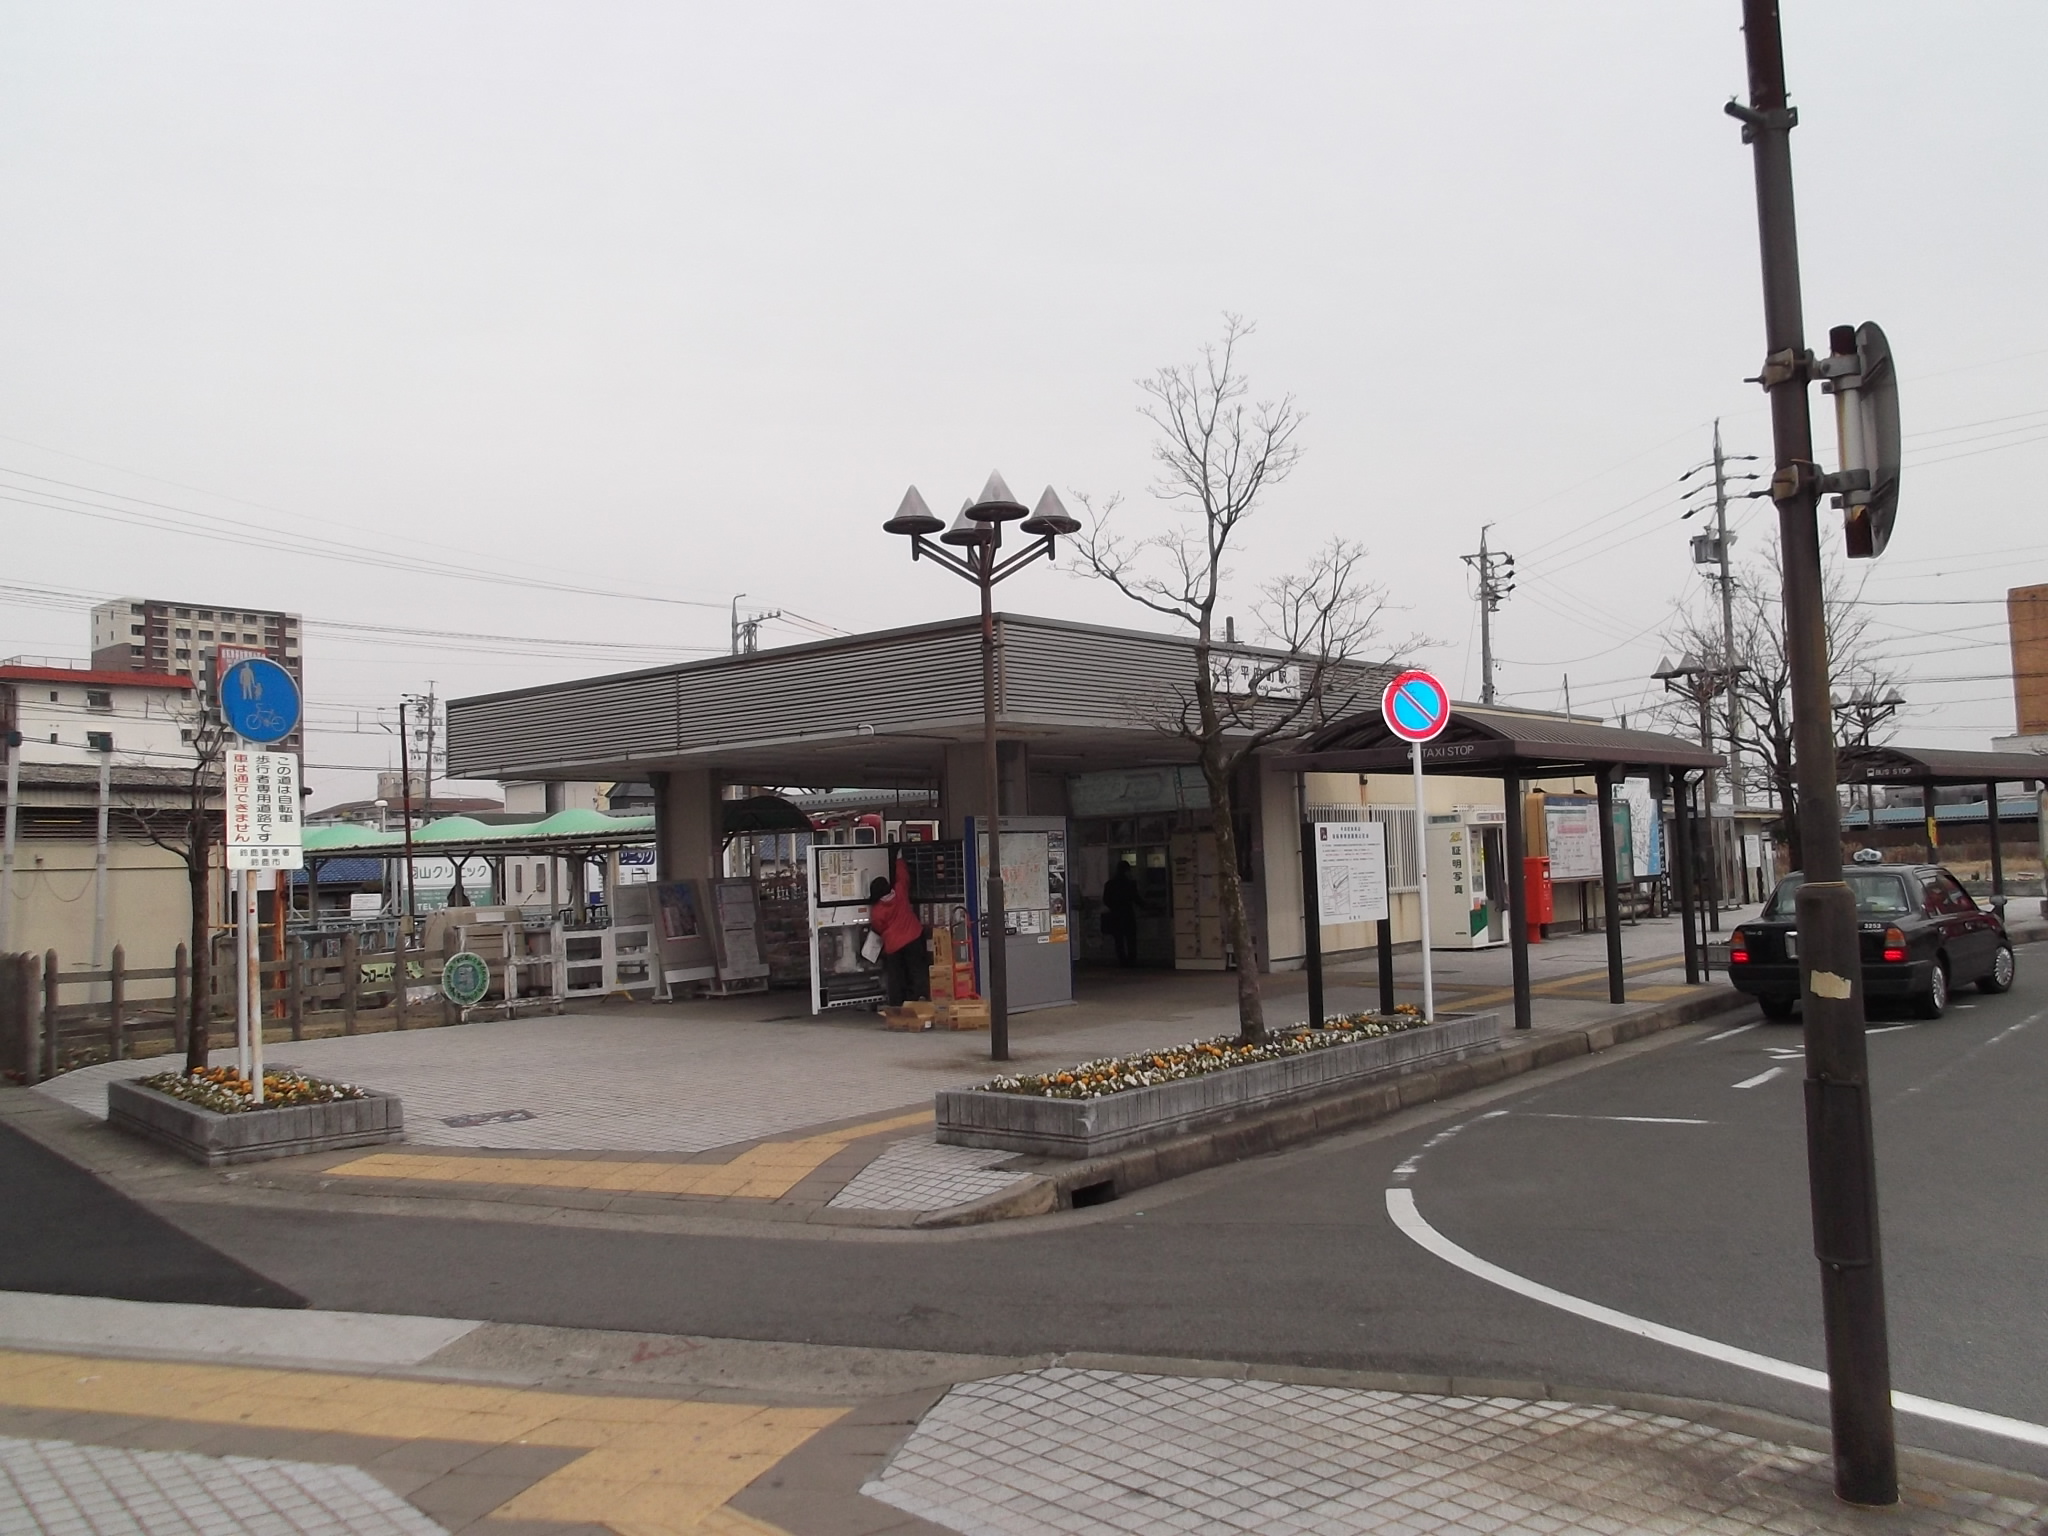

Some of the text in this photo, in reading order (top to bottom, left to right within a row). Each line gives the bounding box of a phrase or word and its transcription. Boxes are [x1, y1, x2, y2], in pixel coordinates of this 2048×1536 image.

[1422, 745, 1475, 758] TAXI STOP
[1875, 767, 1912, 776] BUS STOP
[233, 753, 250, 843] 車は通行できません
[256, 755, 273, 843] 歩行者専用道路です
[277, 756, 294, 823] この道は自転車
[1451, 846, 1464, 895] 証明写真
[417, 903, 434, 911] TEL
